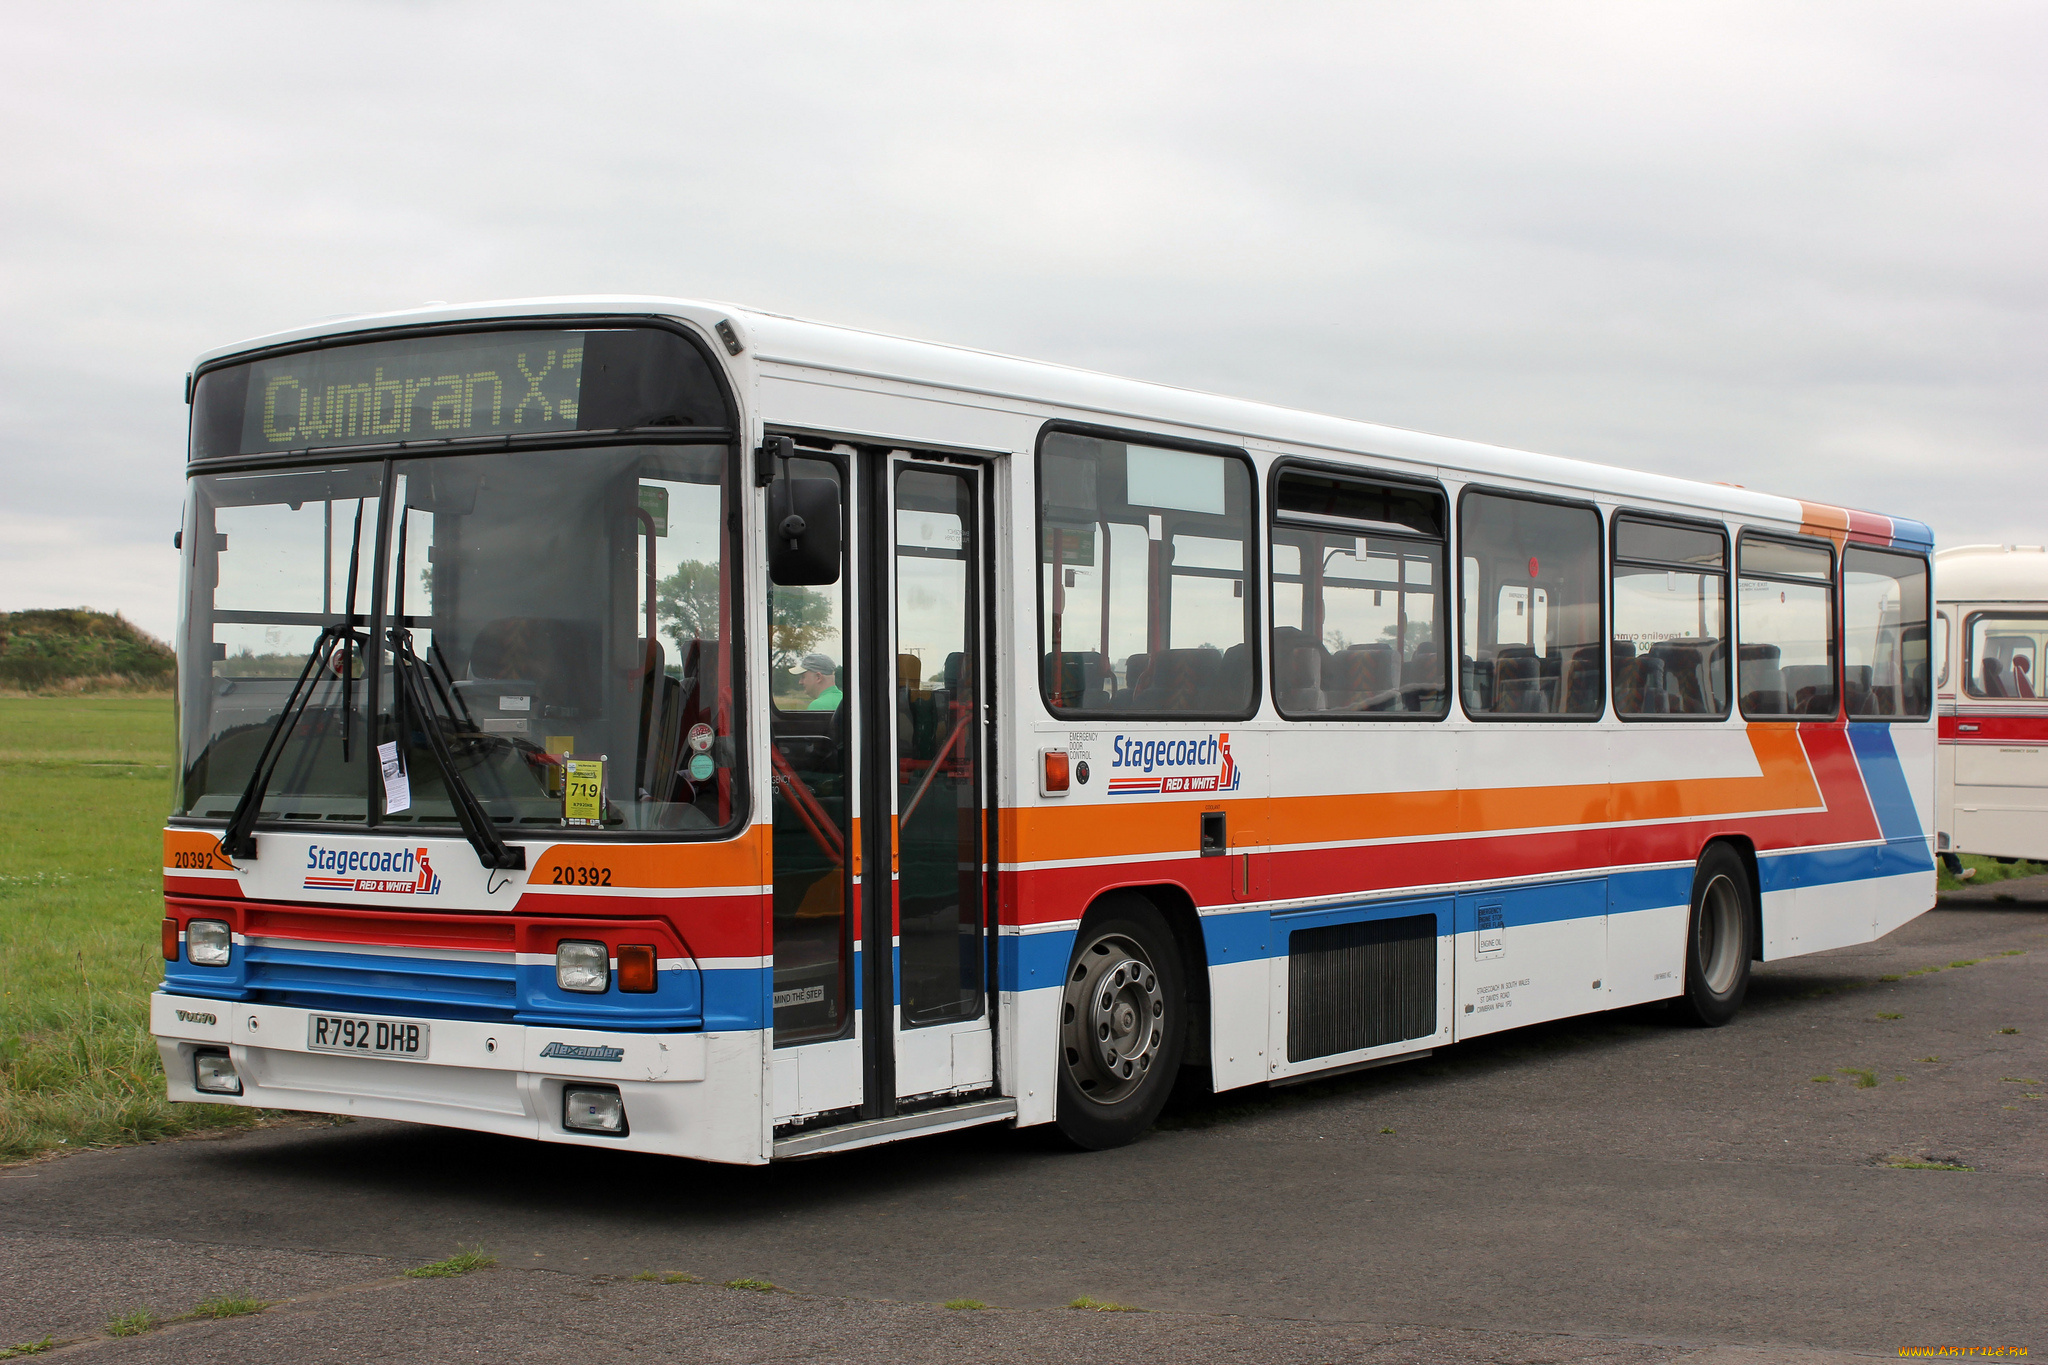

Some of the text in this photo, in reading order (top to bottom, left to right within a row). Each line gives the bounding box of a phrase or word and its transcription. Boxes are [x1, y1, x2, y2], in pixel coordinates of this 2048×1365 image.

[263, 367, 502, 442] Cwmbran
[1069, 732, 1098, 741] EMERGENCY
[1069, 742, 1083, 750] DOOR
[1112, 734, 1218, 773] Stagecoach
[1069, 750, 1092, 760] CONTROL
[571, 783, 598, 798] 719
[1165, 777, 1216, 791] RED & WHITE
[174, 851, 213, 870] 20392
[307, 845, 414, 875] Stagecoach
[552, 865, 612, 886] 20392
[359, 880, 413, 893] RED & WHITE
[774, 989, 823, 1005] MIND THE STEP
[175, 1009, 217, 1026] VOLVO
[315, 1017, 420, 1053] R792 DHB
[540, 1042, 624, 1062] Alexander
